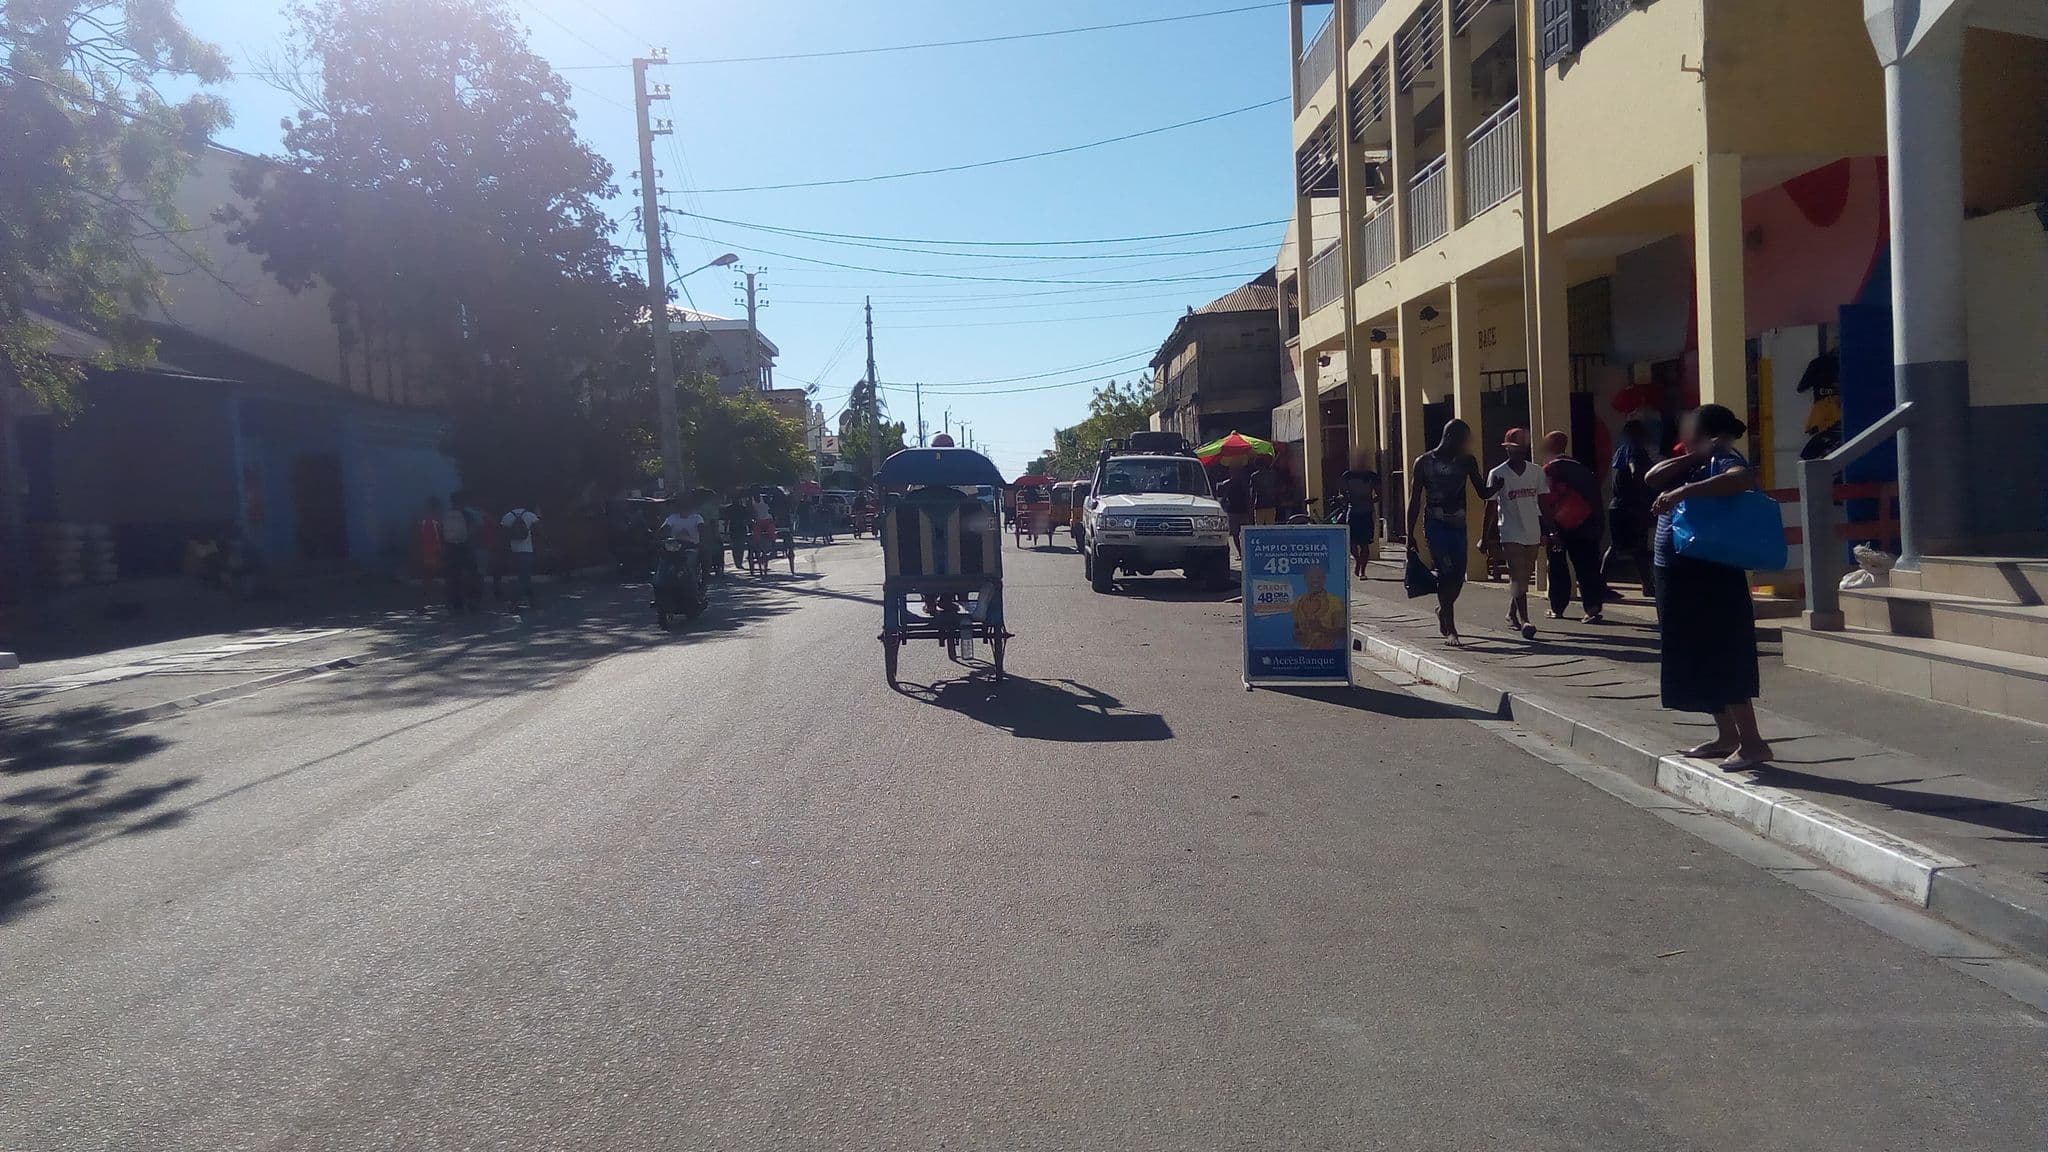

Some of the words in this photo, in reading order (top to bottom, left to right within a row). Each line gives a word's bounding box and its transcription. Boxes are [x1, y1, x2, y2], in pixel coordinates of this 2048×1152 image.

[1254, 544, 1288, 552] AMPIO
[1290, 544, 1328, 552] TOSIKA
[1264, 557, 1290, 574] 48
[1257, 592, 1274, 603] 48
